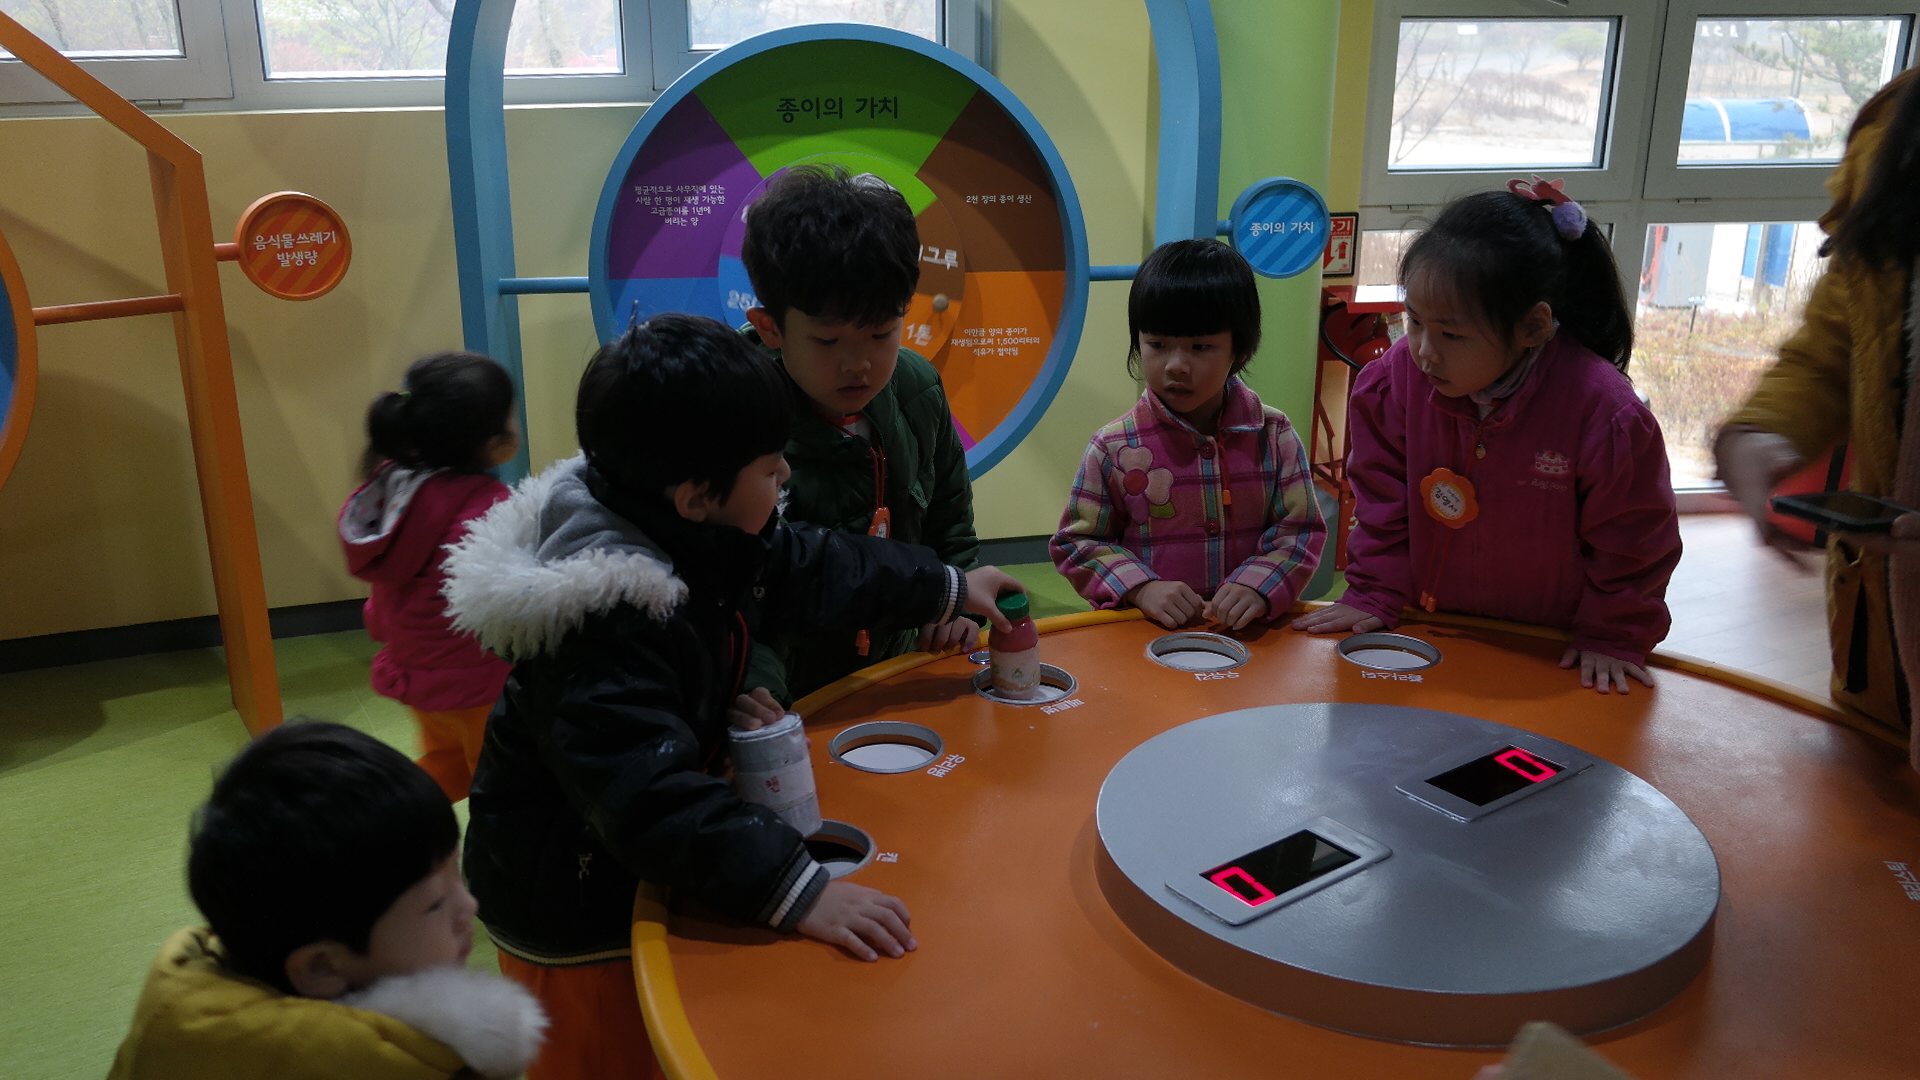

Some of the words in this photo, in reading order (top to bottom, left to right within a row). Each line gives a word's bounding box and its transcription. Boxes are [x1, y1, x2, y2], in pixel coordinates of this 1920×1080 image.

[776, 97, 843, 123] 종이의
[855, 96, 898, 119] 가치
[634, 185, 673, 195] 평균적으로
[675, 184, 707, 194] 사무직에
[709, 184, 725, 194] 있는
[635, 196, 651, 205] 사람
[654, 196, 662, 205] 한
[665, 196, 680, 205] 명이
[683, 196, 699, 205] 재생
[702, 195, 725, 204] 가능한
[965, 195, 978, 204] 2천
[981, 195, 996, 204] 장의
[999, 195, 1014, 204] 종이
[1016, 194, 1032, 203] 생산
[650, 206, 689, 216] 고급종이를
[692, 206, 711, 215] 1년에
[664, 217, 688, 226] 버리는
[690, 217, 699, 226] 양
[1250, 221, 1285, 237] 종이의
[1291, 221, 1314, 234] 가치
[277, 250, 318, 267] 발생량
[906, 323, 933, 346] 1톤
[964, 328, 986, 337] 이만큼
[988, 328, 1003, 337] 양의
[1005, 327, 1028, 336] 종이가
[996, 337, 1040, 346] 1,500리터의
[973, 348, 994, 357] 석유가
[997, 347, 1019, 356] 절약됨
[926, 754, 966, 778] 유리병
[876, 852, 899, 863] 캔
